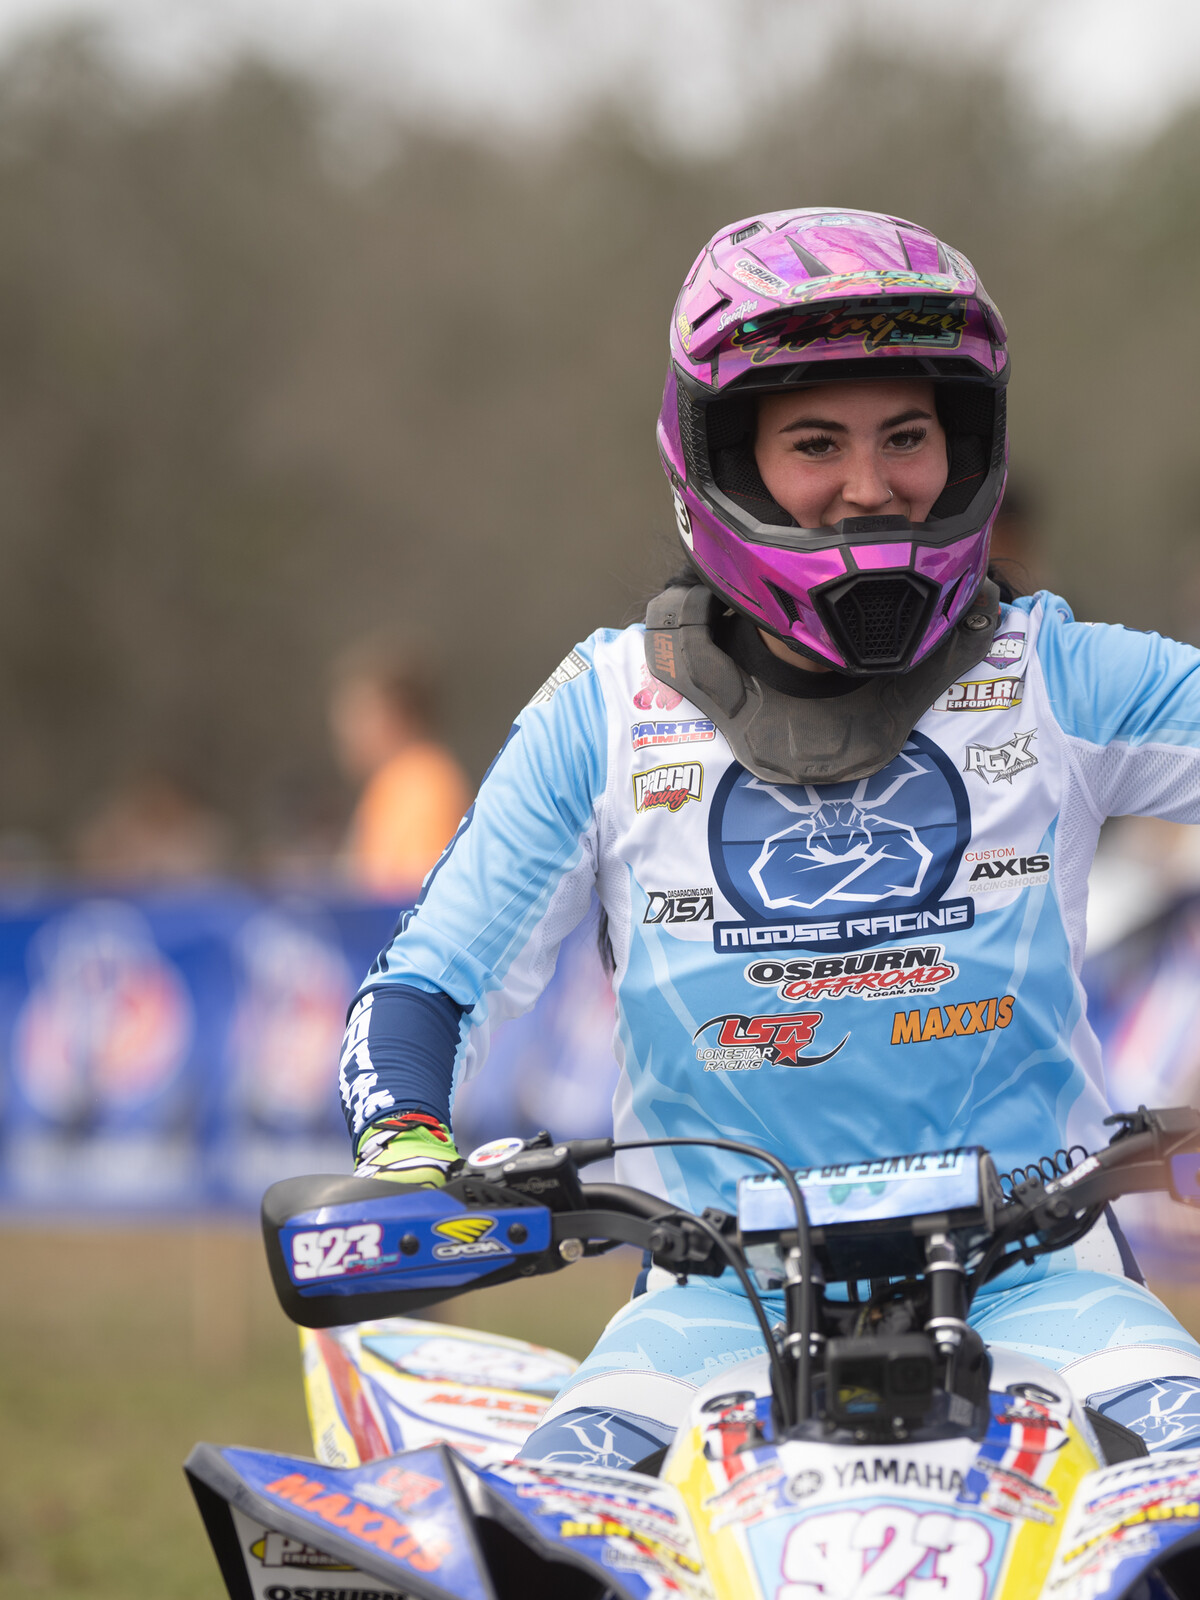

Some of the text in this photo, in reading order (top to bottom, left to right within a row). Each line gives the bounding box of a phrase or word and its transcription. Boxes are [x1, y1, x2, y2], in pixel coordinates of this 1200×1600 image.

[738, 260, 786, 288] OSBURN
[632, 719, 715, 741] PARTS
[633, 732, 714, 749] UNLIMITED
[641, 785, 689, 808] Racing
[964, 847, 1015, 862] CUSTOM
[969, 855, 1050, 881] AXIS
[643, 892, 714, 923] DASA
[720, 905, 968, 947] MOOSE RACING
[752, 948, 938, 981] OSBURN
[785, 966, 952, 998] OFFROAD
[867, 989, 906, 998] LOGAN,
[720, 1014, 820, 1045] LSR
[890, 995, 1015, 1046] MAXXIS
[696, 1047, 774, 1061] LONESTAR
[704, 1059, 763, 1072] RACING
[293, 1223, 381, 1280] 923
[834, 1458, 967, 1494] YAMAHA
[265, 1474, 452, 1572] MAXXIS
[777, 1505, 993, 1600] 923
